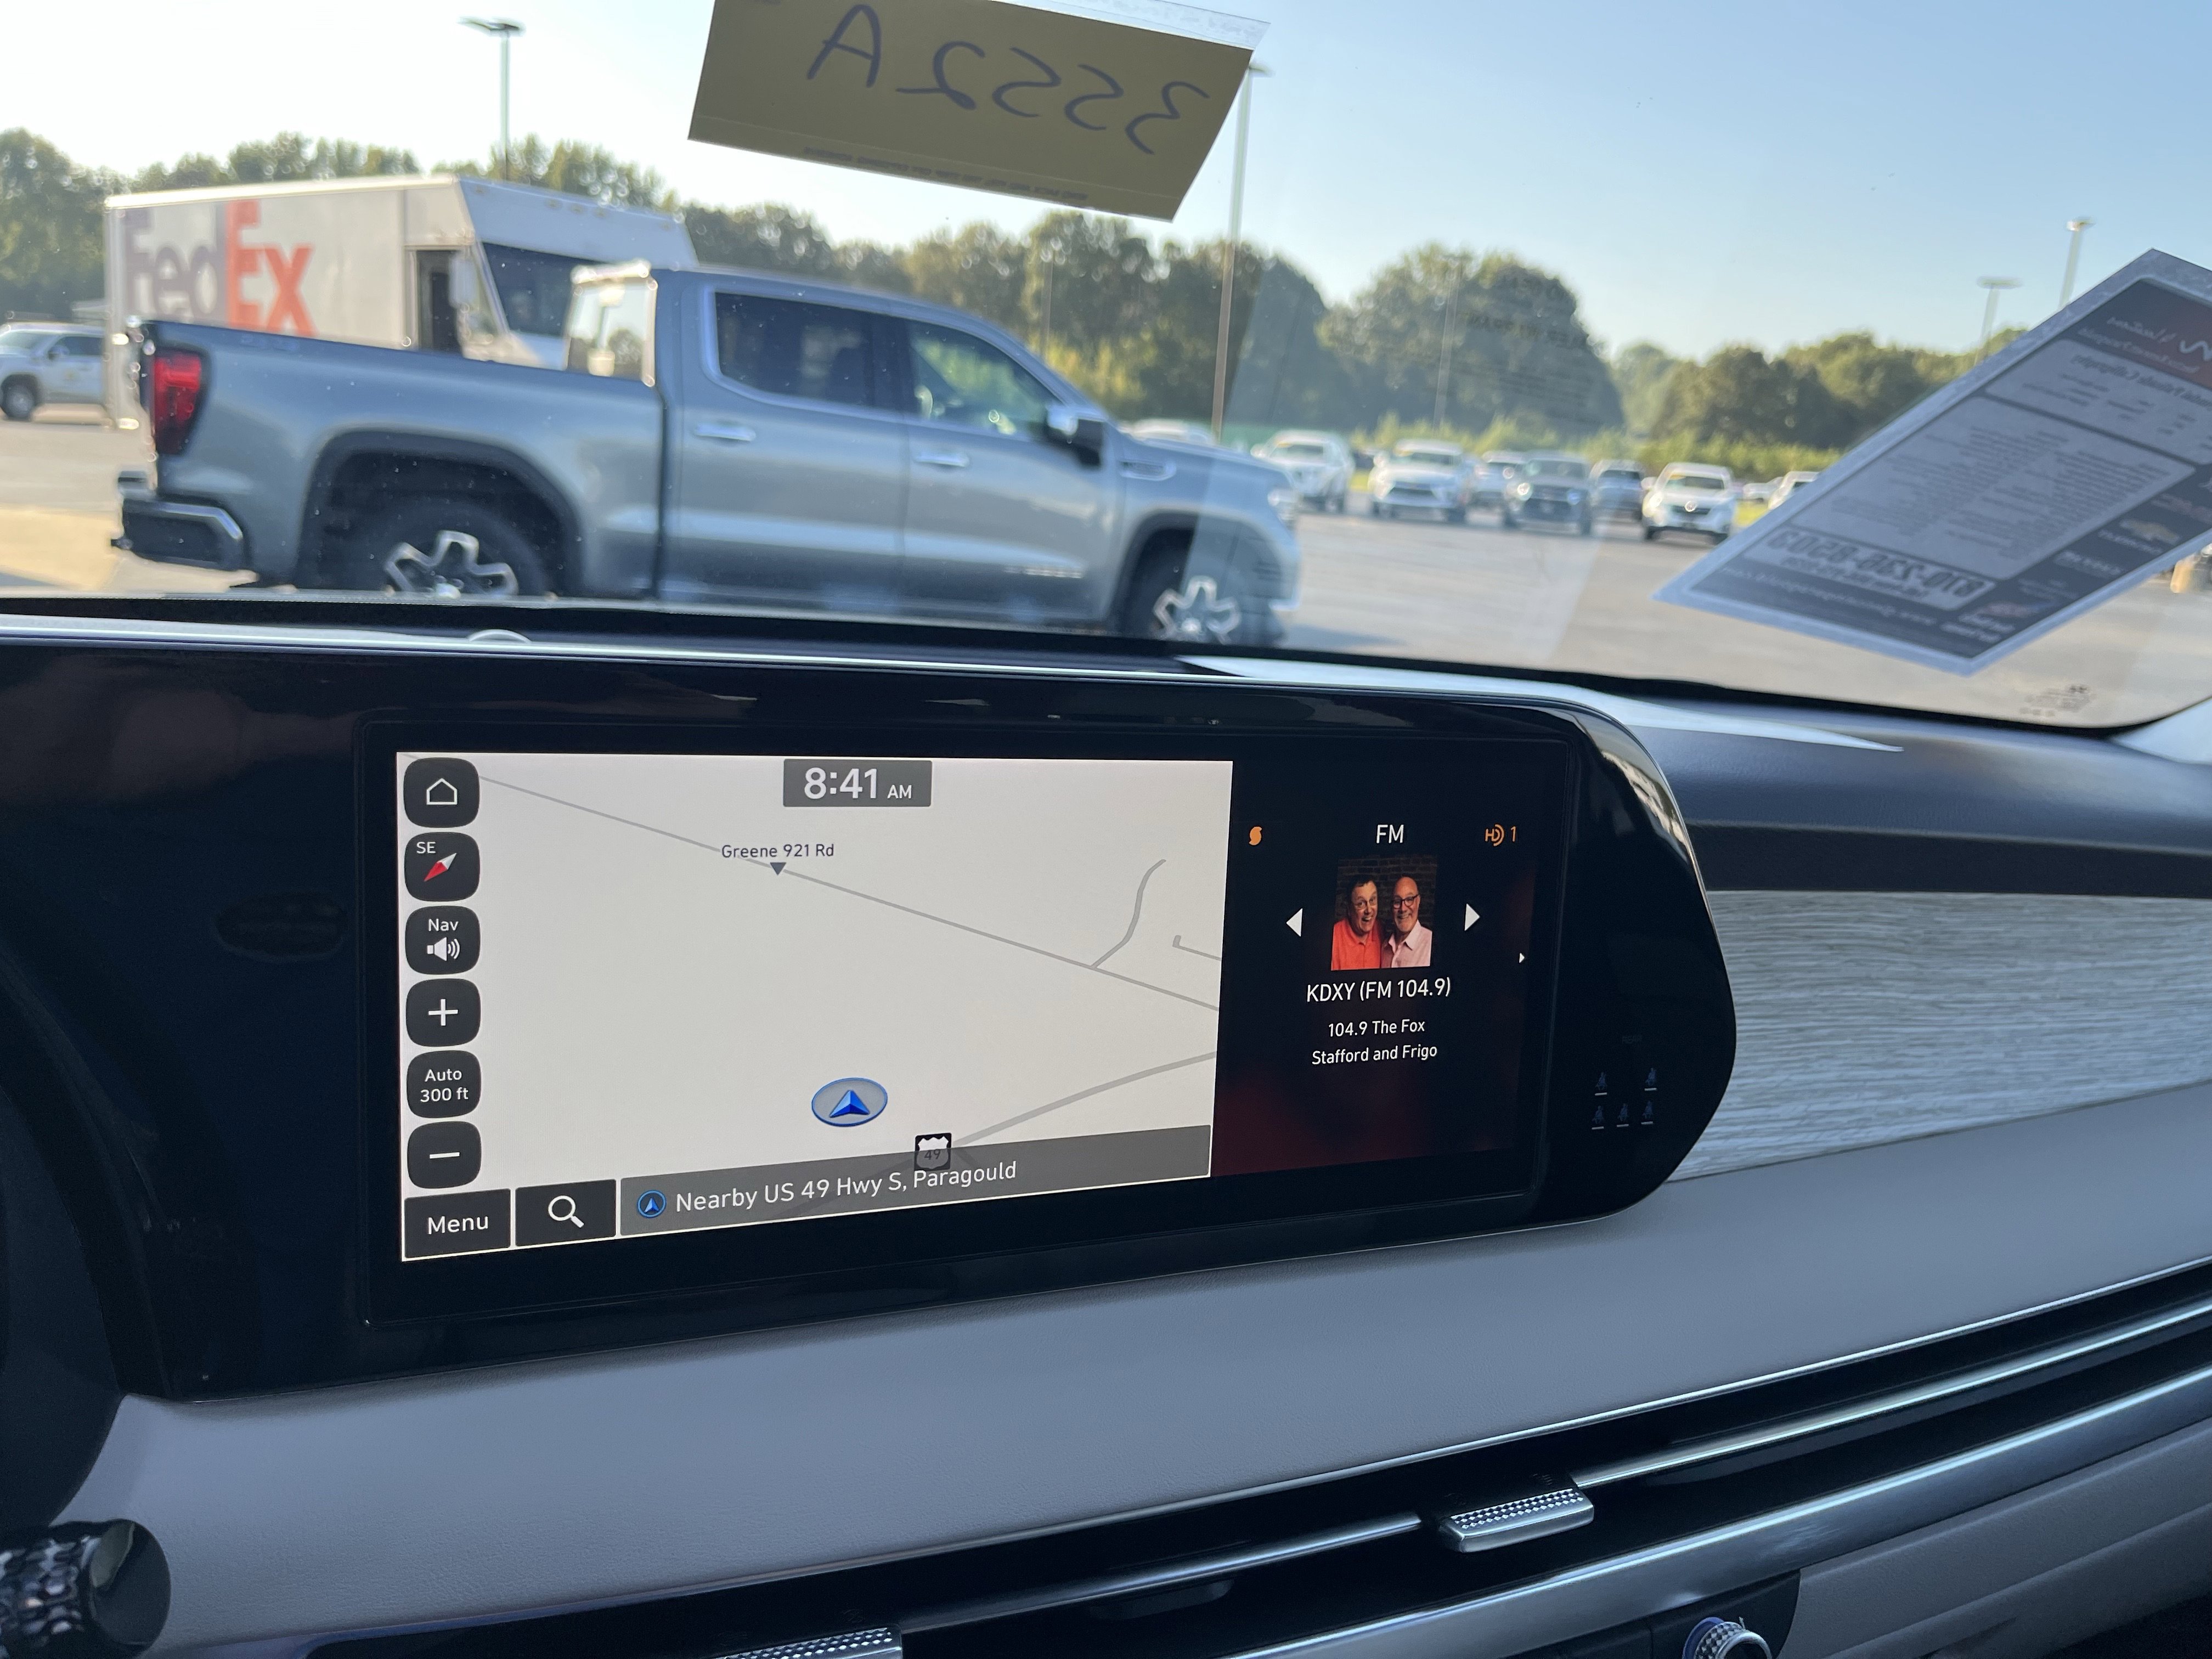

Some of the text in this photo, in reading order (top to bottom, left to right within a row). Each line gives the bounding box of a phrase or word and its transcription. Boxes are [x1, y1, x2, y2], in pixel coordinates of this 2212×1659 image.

[122, 199, 317, 336] FedEx
[804, 768, 913, 799] 8:41 AM
[1376, 825, 1404, 844] FM
[416, 842, 436, 854] SE
[721, 844, 834, 858] Greene 921 Rd
[428, 918, 459, 932] Nav
[1306, 977, 1452, 1003] KDXY (FM 104.9)
[1328, 1019, 1425, 1037] 104.9 The Fox
[1312, 1043, 1438, 1065] Stafford and Frigo
[425, 1068, 462, 1082] Auto
[420, 1086, 469, 1103] 300 ft
[924, 1149, 941, 1160] 49
[676, 1161, 1017, 1212] Nearby US 49 Hwy S, Paragould
[427, 1215, 489, 1235] Menu
